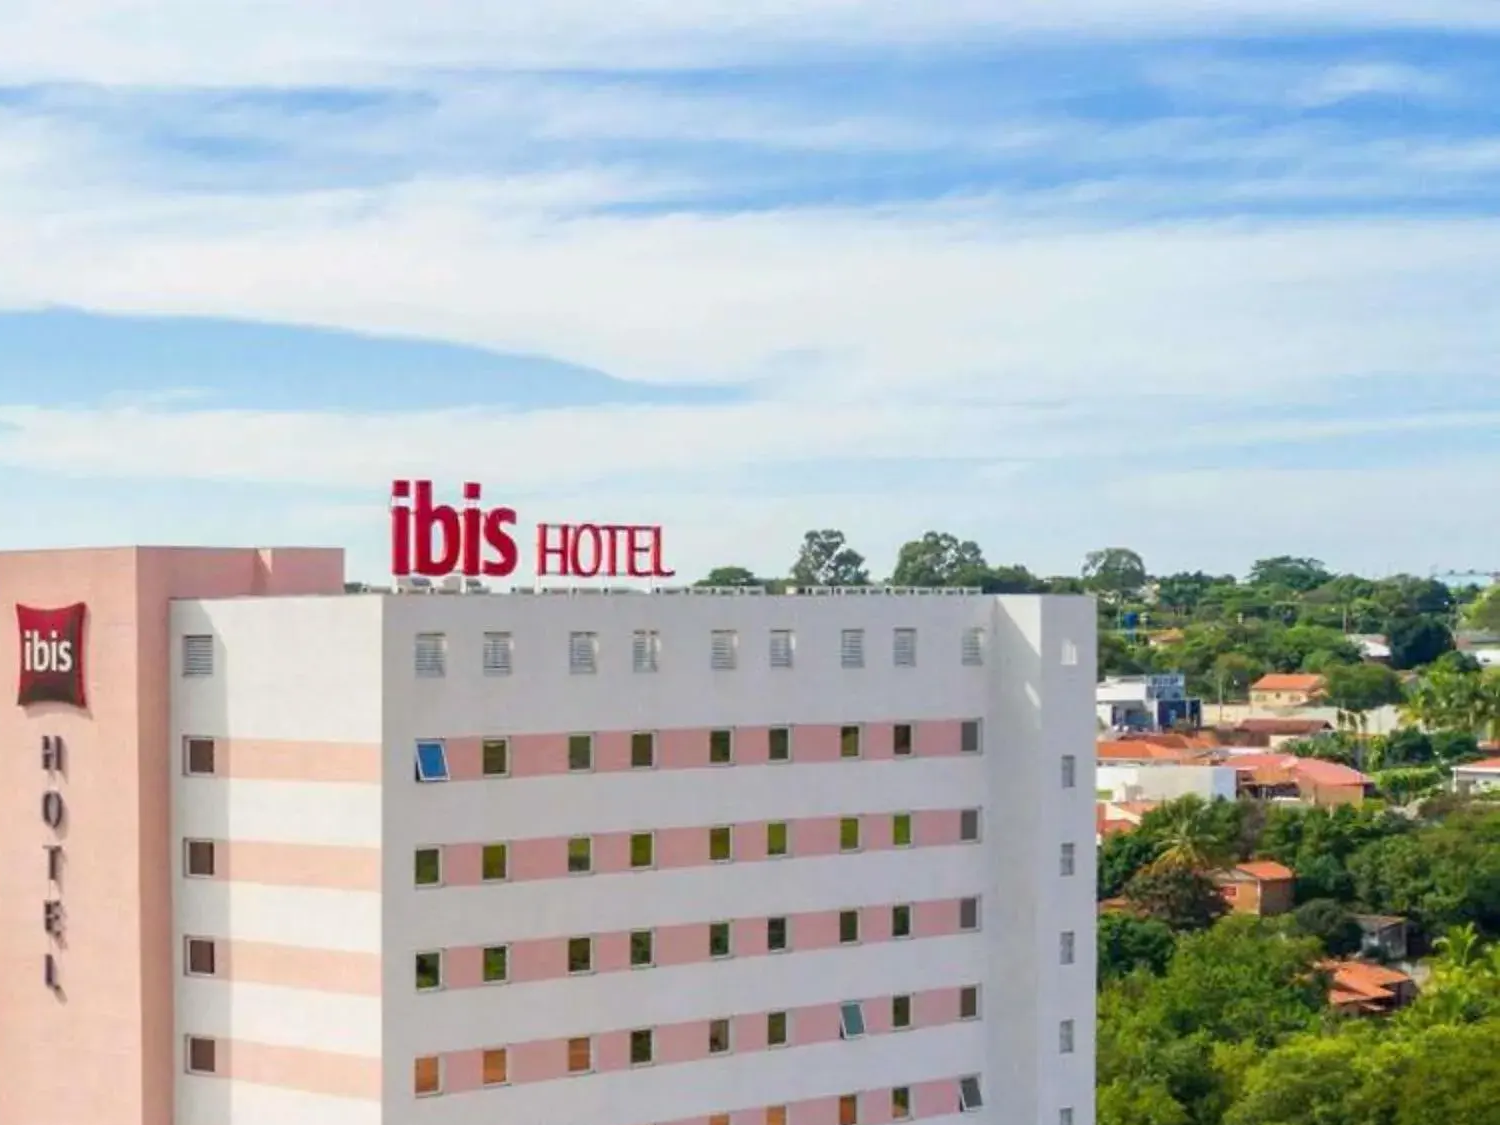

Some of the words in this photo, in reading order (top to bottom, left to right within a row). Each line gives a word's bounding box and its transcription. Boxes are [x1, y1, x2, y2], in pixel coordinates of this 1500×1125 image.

[392, 480, 518, 577] ibis
[537, 523, 676, 577] HOTEL
[24, 629, 73, 672] ibis
[42, 735, 64, 989] HOTEL
